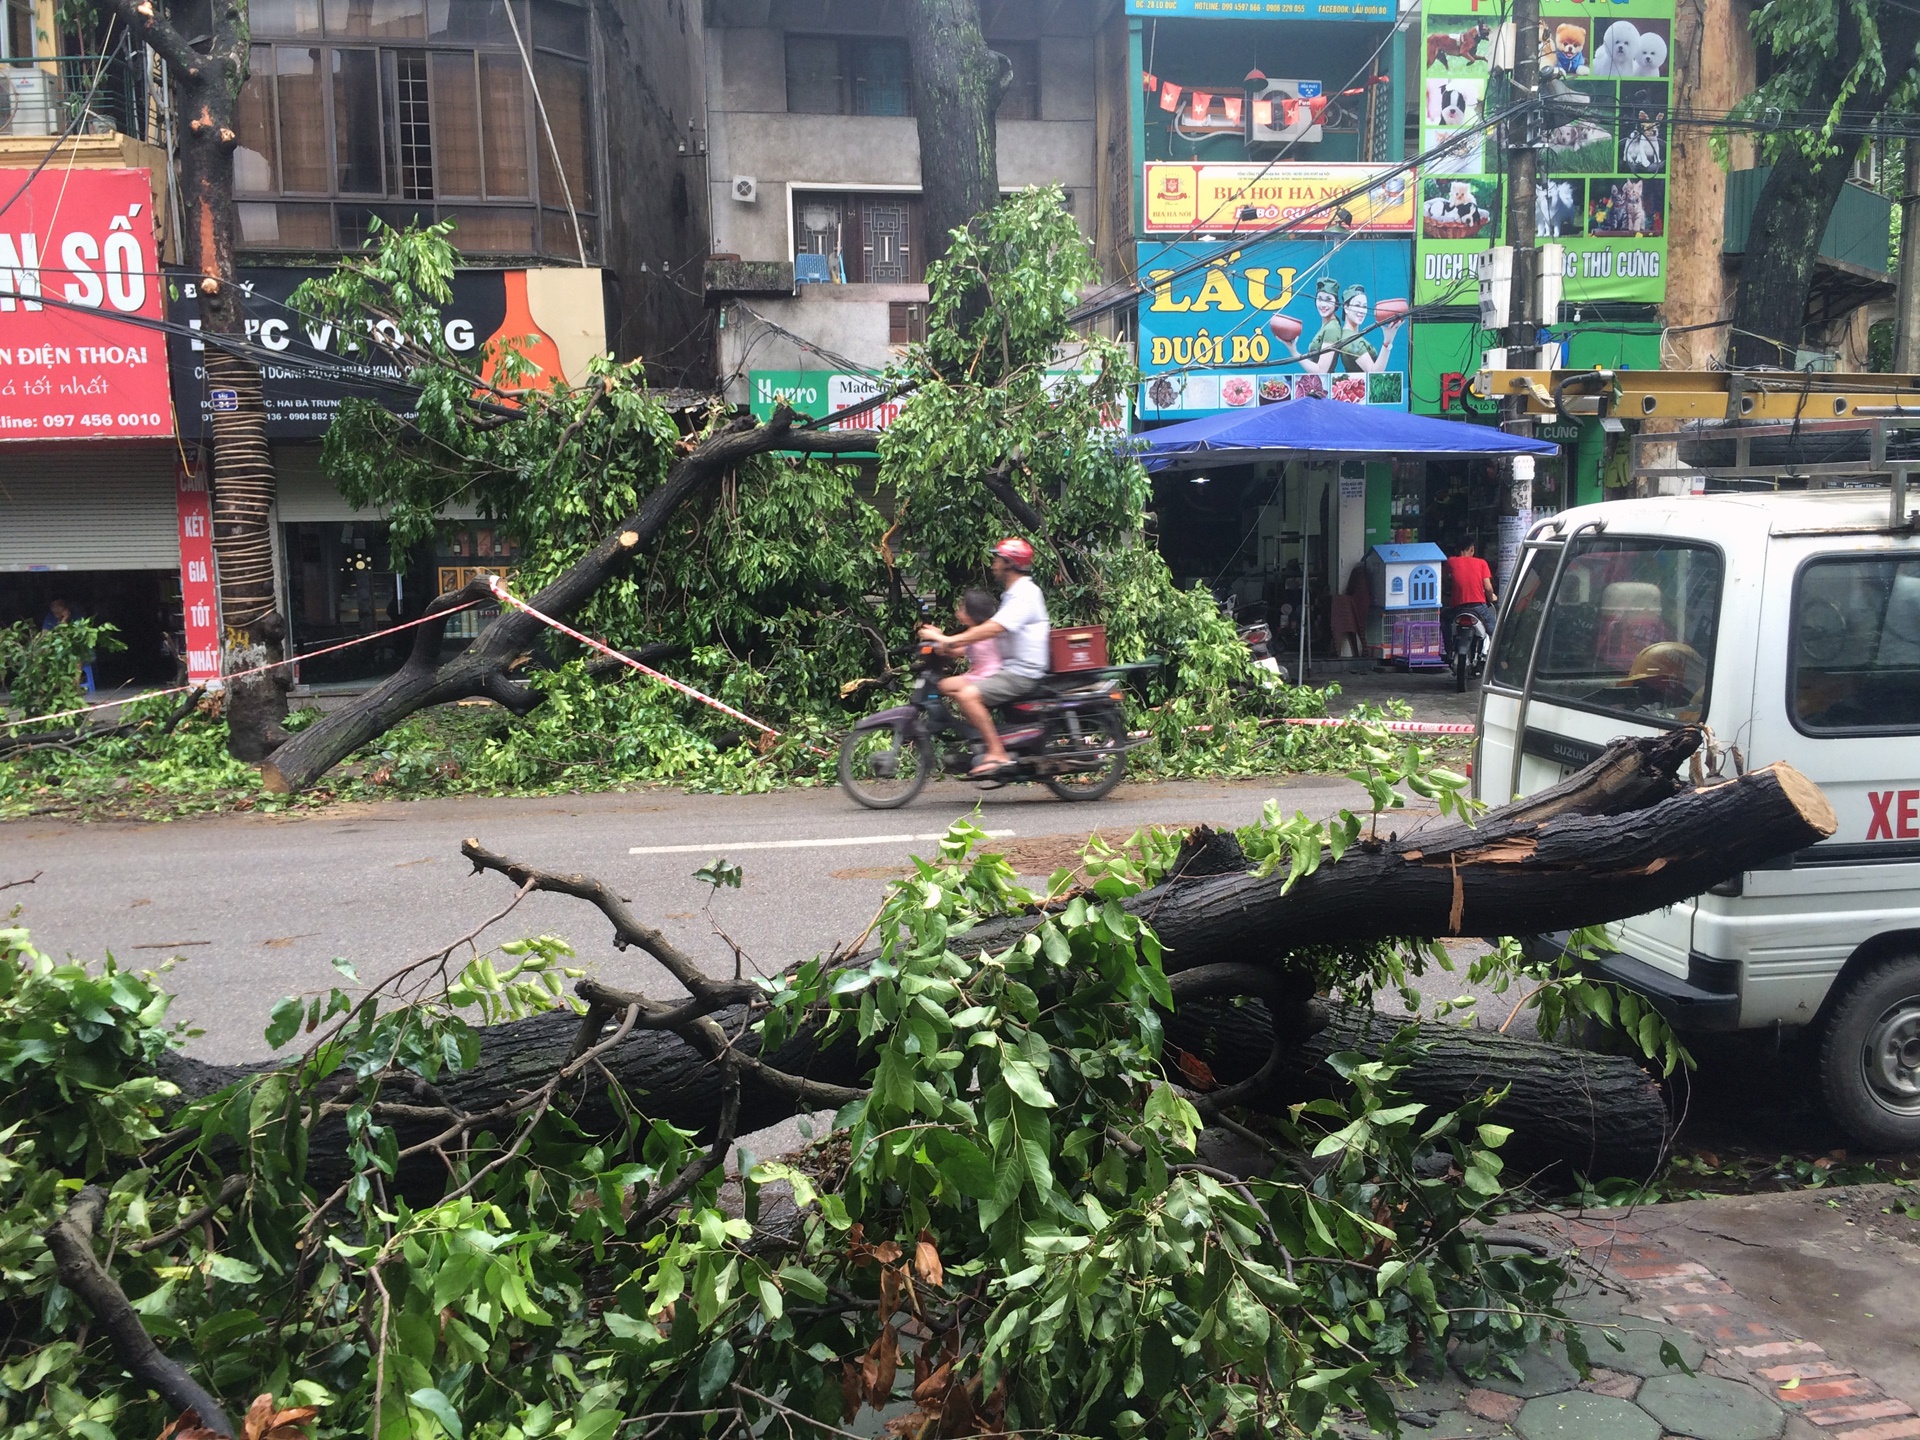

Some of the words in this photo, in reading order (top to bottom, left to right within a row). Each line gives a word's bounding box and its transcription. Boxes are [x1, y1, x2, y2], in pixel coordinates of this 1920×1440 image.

[1214, 186, 1246, 200] BIA
[1251, 186, 1283, 200] HƠI
[1289, 184, 1316, 200] HÀ
[61, 204, 145, 312] SỐ
[1425, 253, 1464, 286] DỊCH
[1582, 246, 1612, 278] THÚ
[1616, 248, 1660, 278] CƯNG
[17, 343, 71, 369] ĐIỆN
[76, 347, 148, 368] THOẠI
[1152, 328, 1223, 365] ĐUÔI
[23, 375, 53, 395] tốt
[60, 375, 110, 395] nhất
[839, 381, 874, 394] Made
[277, 400, 294, 408] HAI
[296, 398, 308, 408] BÀ
[0, 415, 38, 428] line:
[42, 414, 75, 428] 097
[80, 414, 113, 427] 456
[117, 413, 161, 427] 0010
[289, 413, 310, 421] 0904
[312, 413, 328, 421] 882
[1543, 425, 1579, 439] CƯNG
[184, 509, 204, 537] KẾT
[188, 556, 208, 583] GIÁ
[190, 598, 210, 628] TỐT
[227, 627, 250, 650] 34
[189, 642, 218, 672] NHẤT
[1553, 743, 1590, 762] SUZUKI
[1866, 790, 1920, 840] XE
